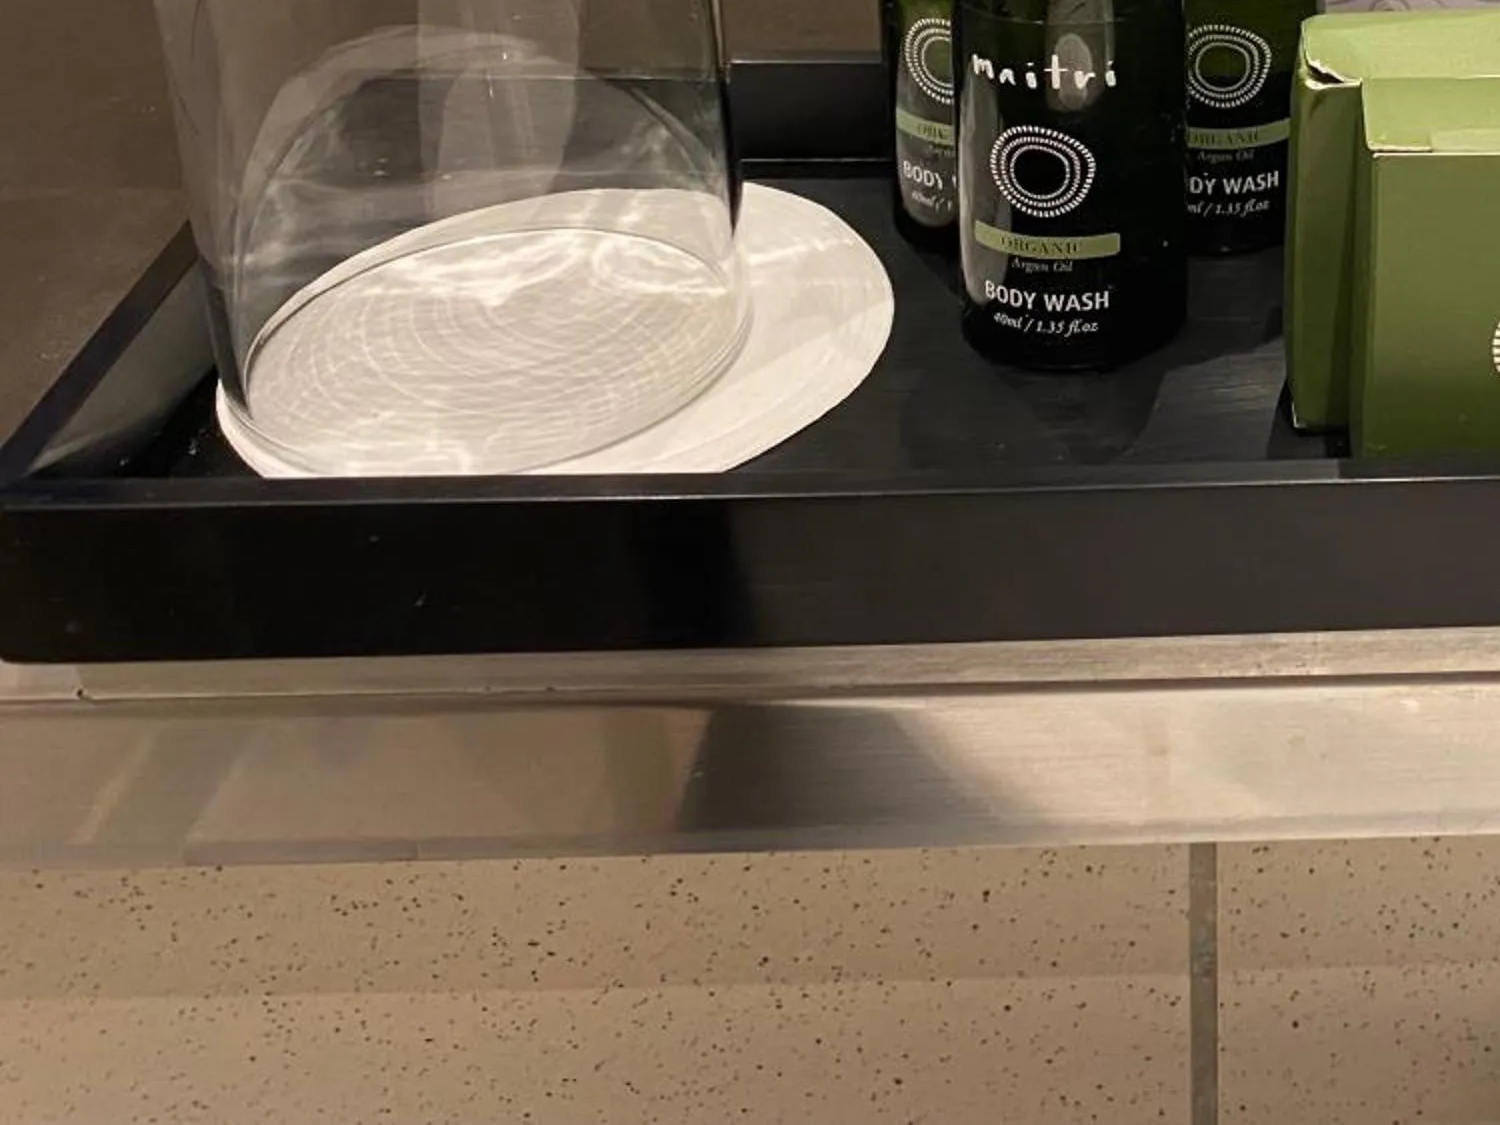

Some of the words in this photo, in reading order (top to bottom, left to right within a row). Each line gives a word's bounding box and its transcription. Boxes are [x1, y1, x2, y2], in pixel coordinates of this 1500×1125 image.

[972, 53, 1117, 90] maitri
[903, 160, 943, 190] BODY
[1189, 173, 1217, 195] DY
[1223, 170, 1279, 194] WASH
[1000, 234, 1082, 255] ORGANIC
[985, 279, 1037, 310] BODY
[1043, 290, 1110, 312] WASH
